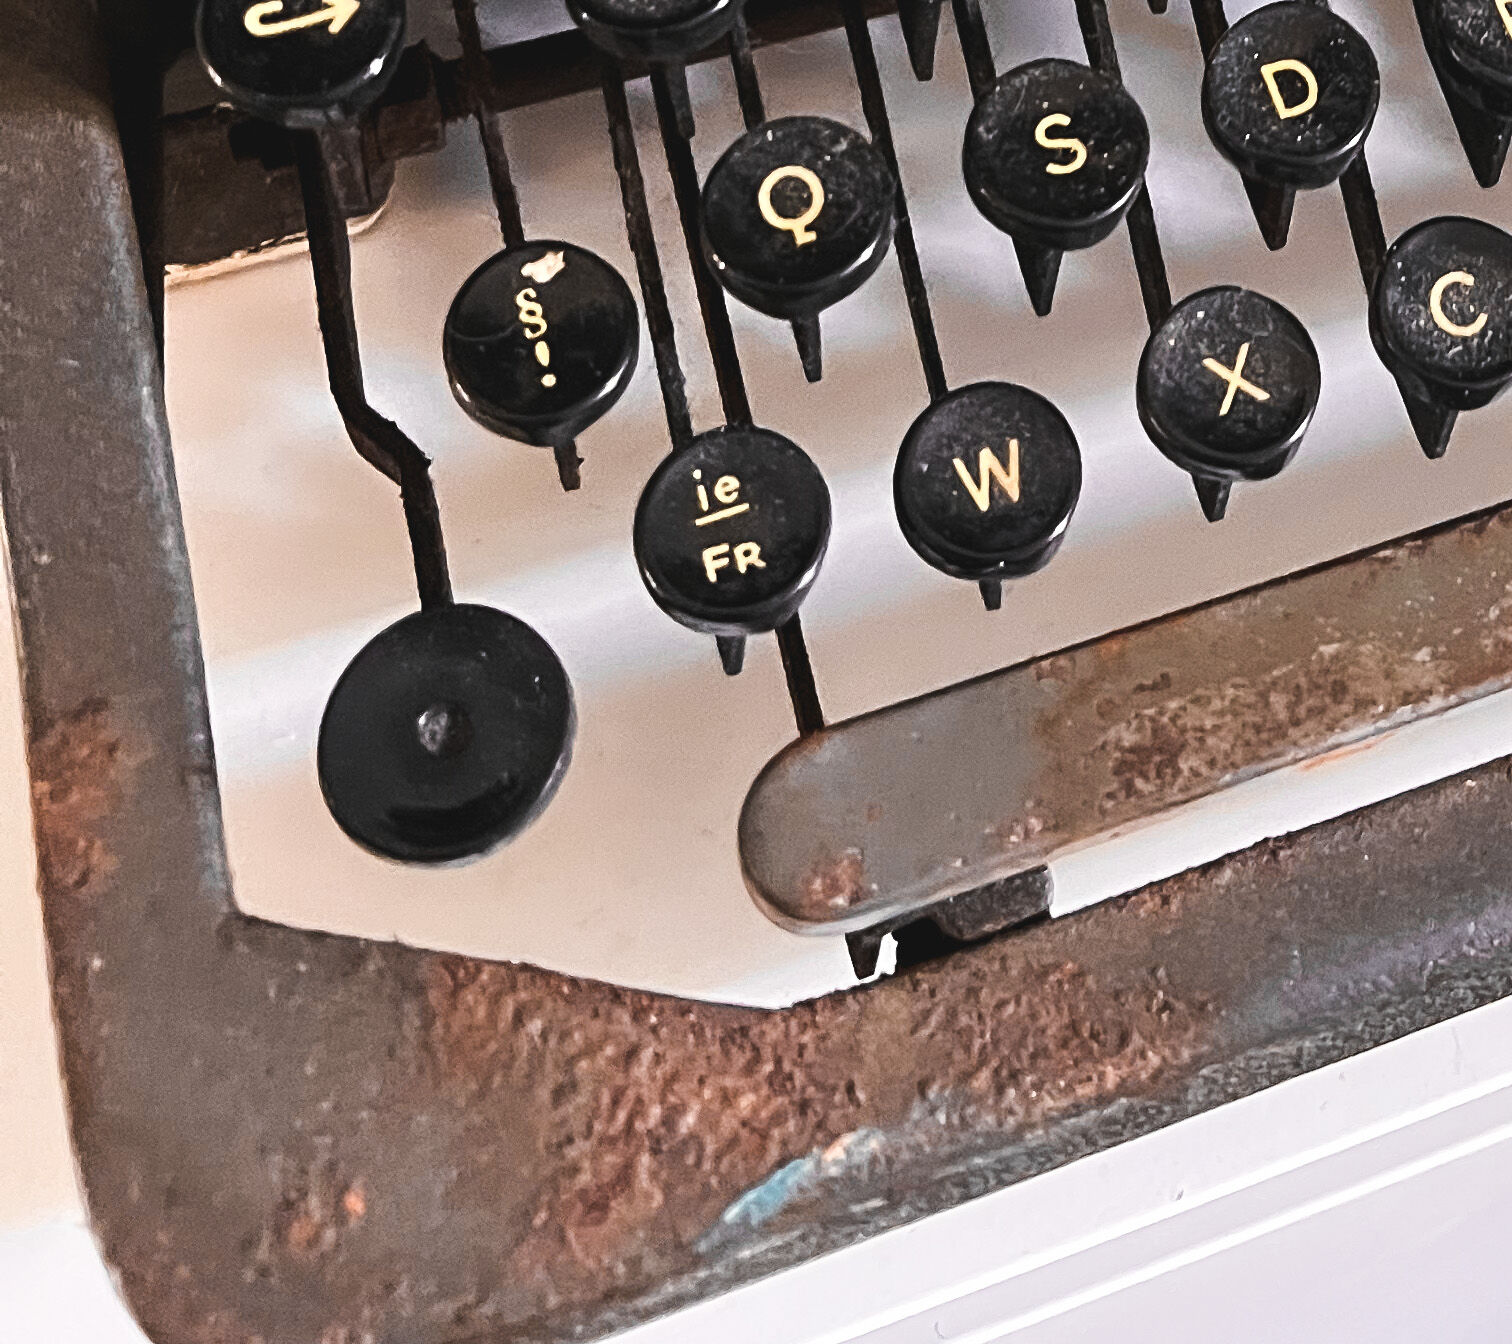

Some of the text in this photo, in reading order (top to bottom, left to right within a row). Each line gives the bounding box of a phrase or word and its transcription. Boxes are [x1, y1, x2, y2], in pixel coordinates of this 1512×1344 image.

[1260, 59, 1319, 120] D
[1034, 113, 1087, 175] S
[757, 165, 825, 246] Q
[1429, 270, 1488, 337] C
[1202, 342, 1271, 416] X
[691, 467, 742, 514] ie
[952, 438, 1020, 512] W
[702, 541, 767, 583] FR
